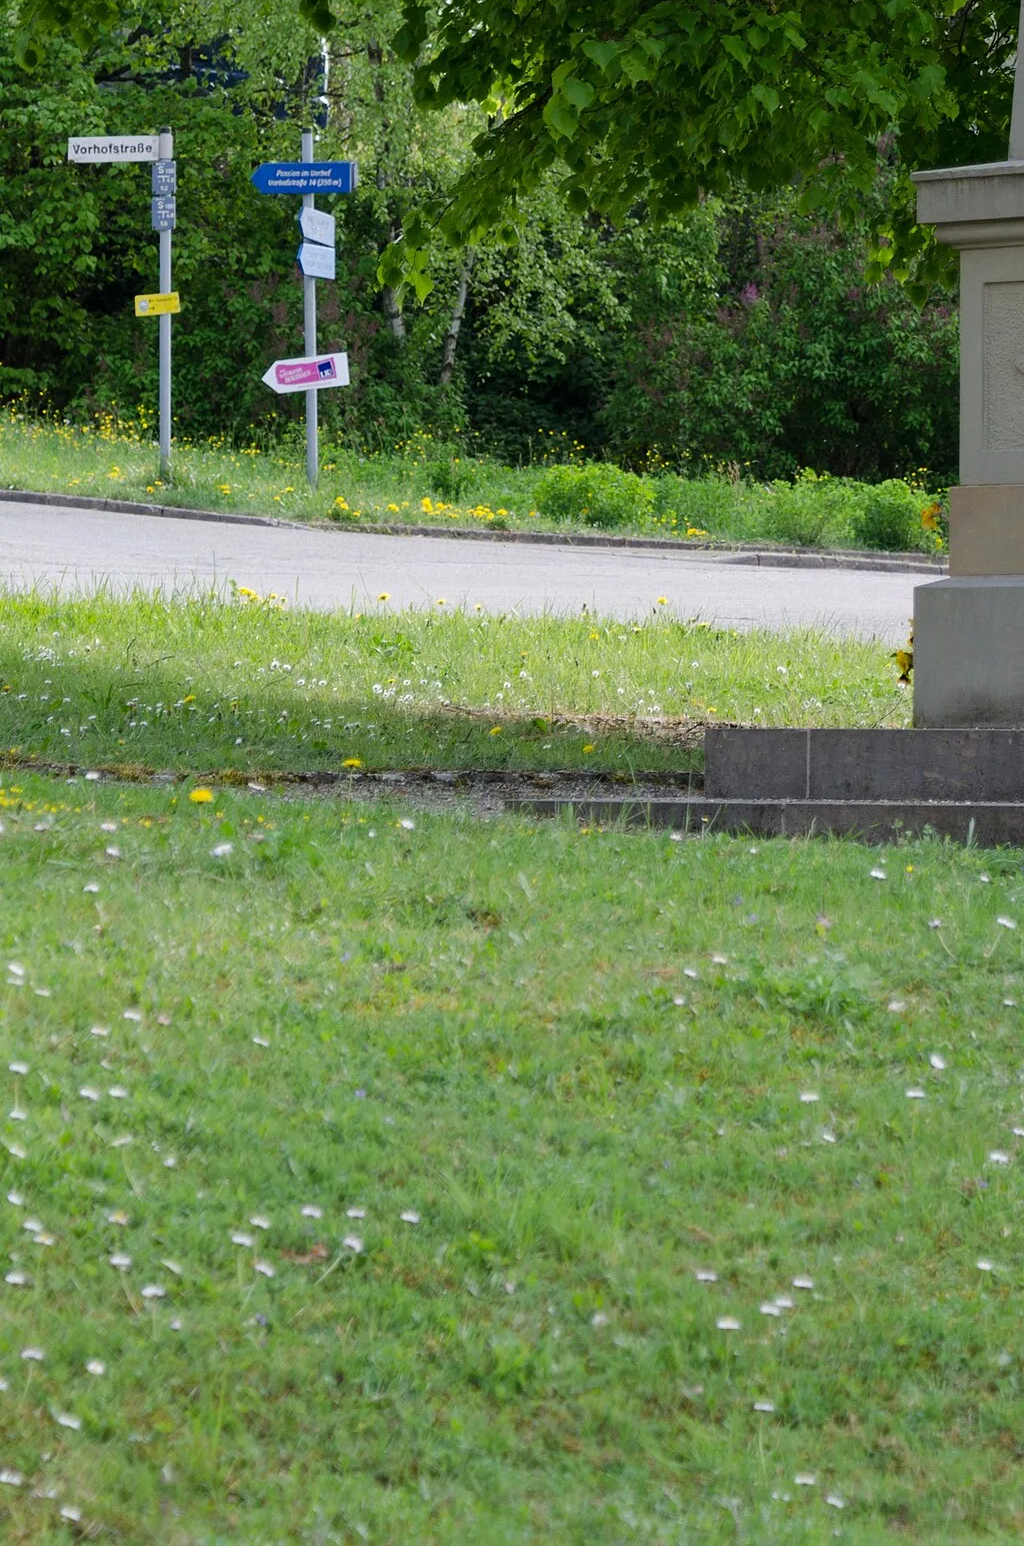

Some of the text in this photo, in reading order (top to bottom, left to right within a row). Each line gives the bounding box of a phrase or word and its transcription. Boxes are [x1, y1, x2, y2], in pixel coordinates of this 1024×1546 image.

[72, 142, 153, 155] Vorhofstraße
[275, 167, 332, 178] Pension im Vorhof
[267, 178, 308, 188] Vorhofstraße
